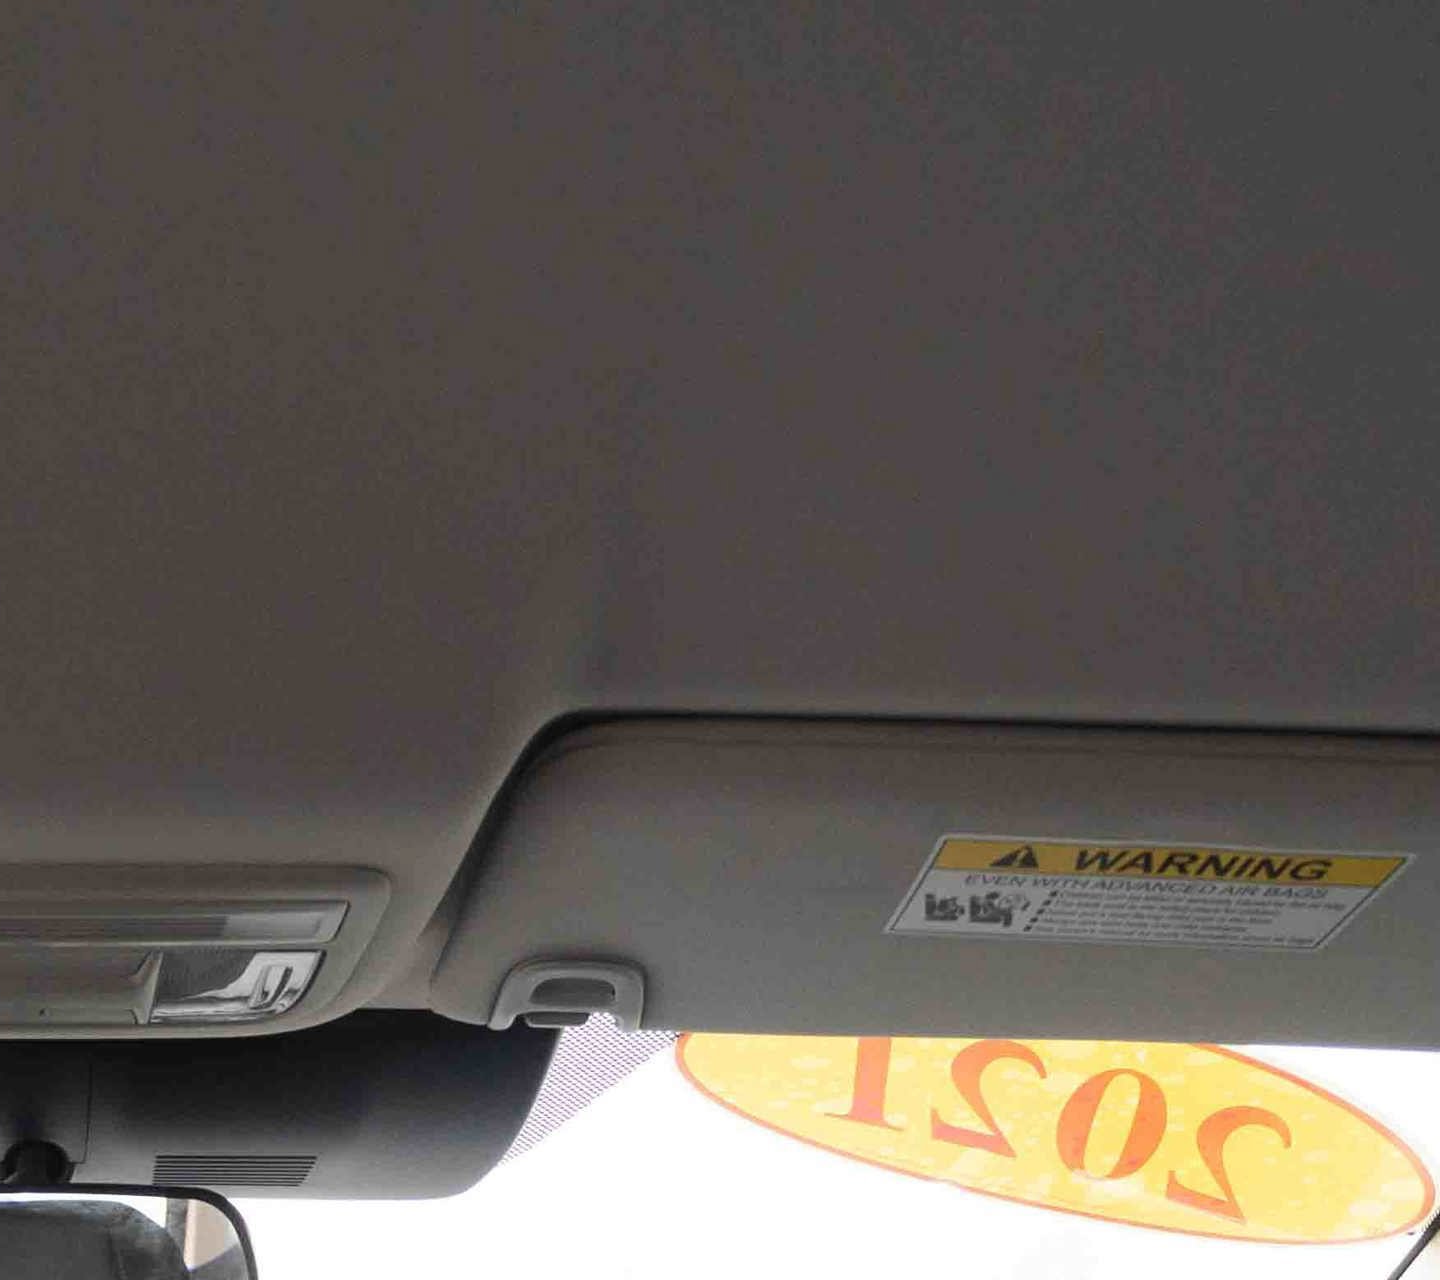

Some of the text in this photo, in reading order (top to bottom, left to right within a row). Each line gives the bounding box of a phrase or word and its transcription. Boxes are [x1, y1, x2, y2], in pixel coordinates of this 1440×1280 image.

[1074, 849, 1334, 881] WARNING
[964, 874, 1329, 899] EVEN WITH ADVANCED AIR BAGS
